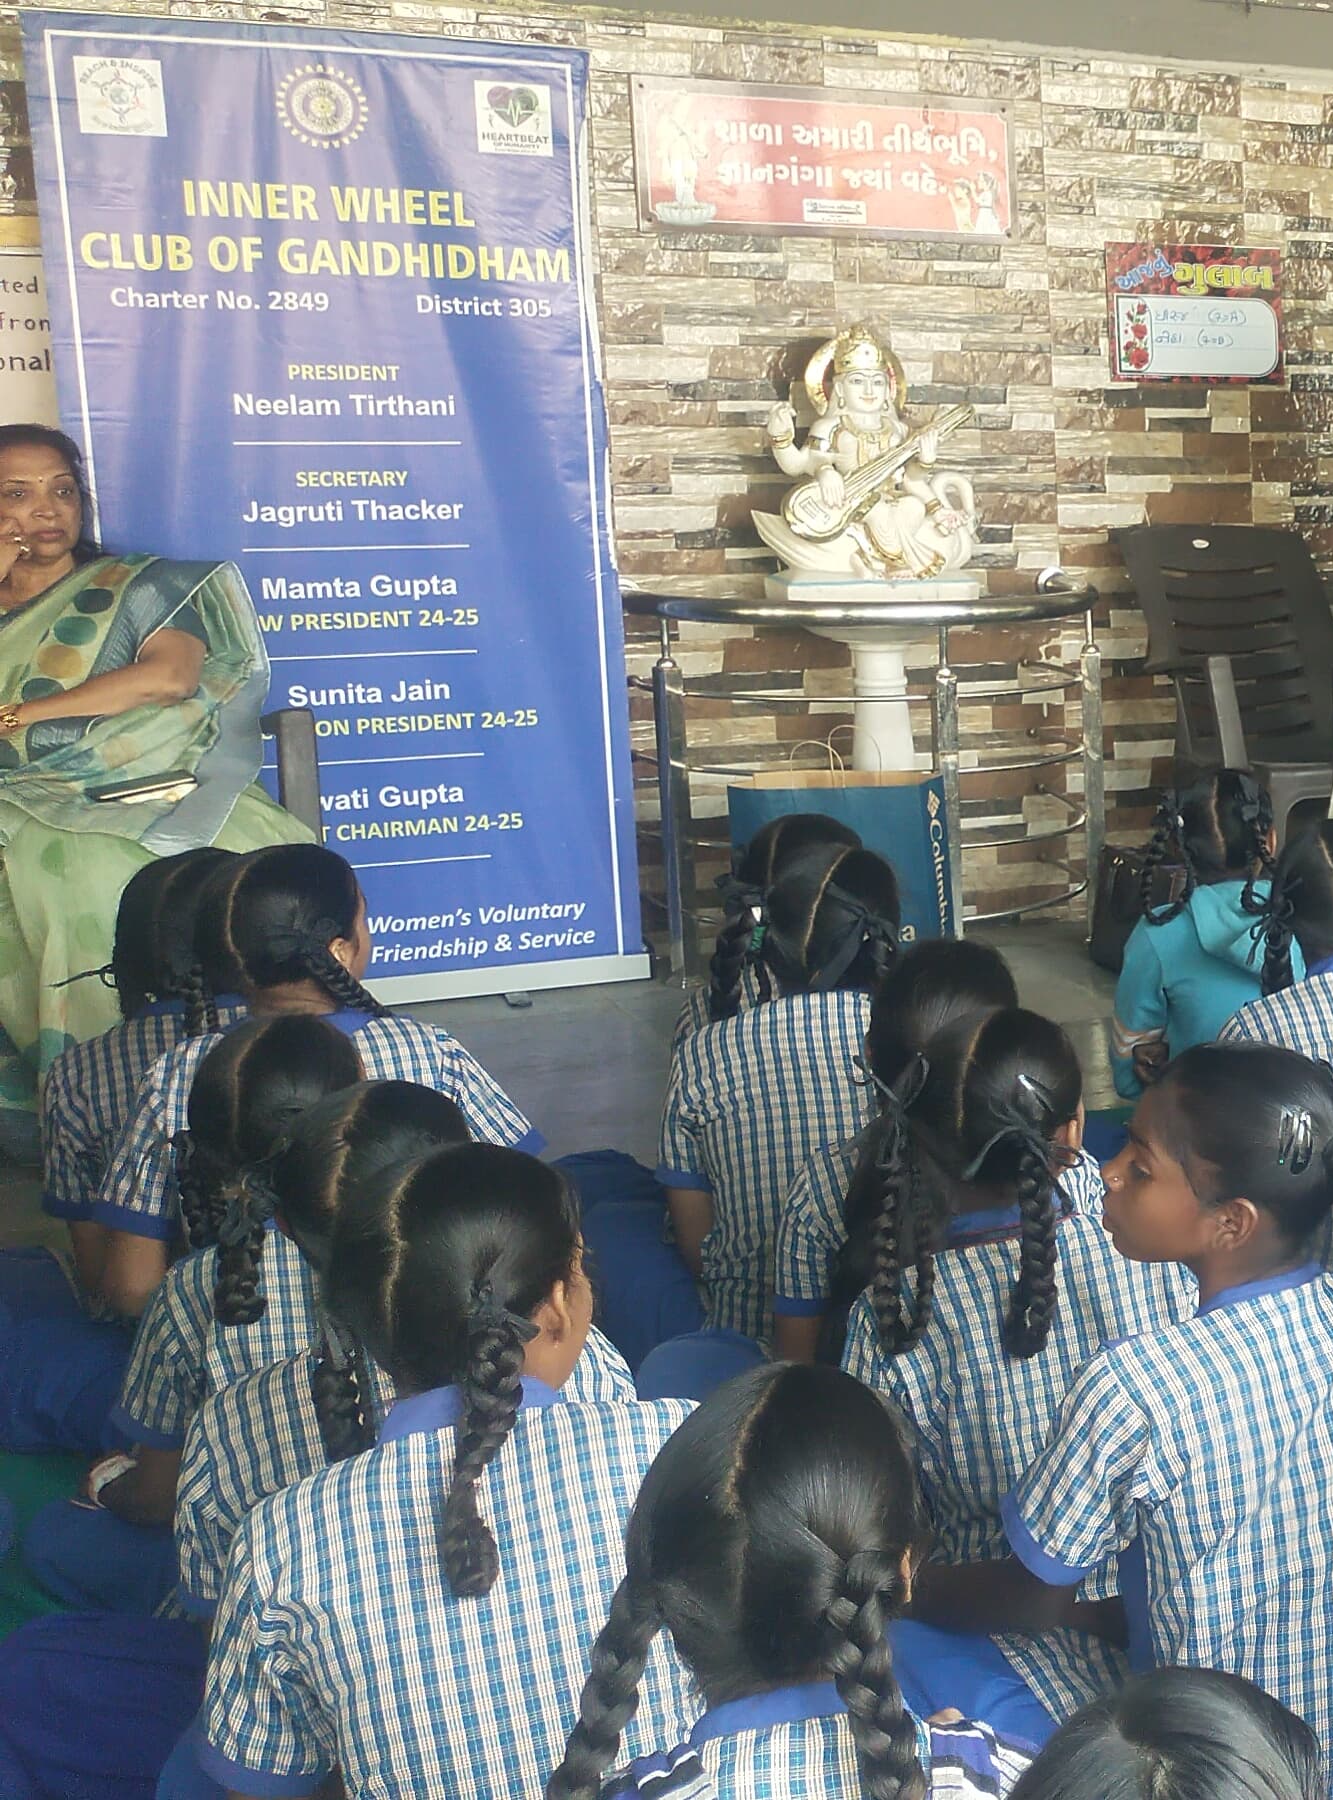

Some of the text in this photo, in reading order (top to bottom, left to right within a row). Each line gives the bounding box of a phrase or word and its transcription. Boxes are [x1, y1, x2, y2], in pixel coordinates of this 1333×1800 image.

[482, 131, 549, 145] HEARTBEAT
[792, 121, 874, 150] અમારી
[882, 122, 998, 166] તીર્થભૂમિ,
[183, 180, 475, 228] INNER WHEEL
[80, 231, 571, 284] CLUB OF GANDHIDHAM
[1115, 248, 1275, 296] આજનું ગુલાબ
[110, 288, 330, 313] Charter No. 2849
[416, 294, 552, 318] District 305
[287, 364, 399, 382] PRESIDENT
[233, 393, 456, 417] Neelam Tirthani
[296, 470, 408, 489] SECRETARY
[243, 499, 463, 524] Jagruti Thacker
[262, 575, 457, 602] Mamta Gupta
[291, 611, 410, 631] PRESIDENT
[418, 608, 479, 627] 24-25
[288, 679, 451, 706] Sunita Jain
[358, 713, 475, 735] PRESIDENT
[482, 710, 538, 728] 24-25
[379, 783, 464, 810] Gupta
[336, 817, 458, 842] CHAIRMAN
[464, 813, 523, 833] 24-25
[368, 900, 586, 935] Women's Voluntary
[371, 927, 596, 964] Friendship & Service
